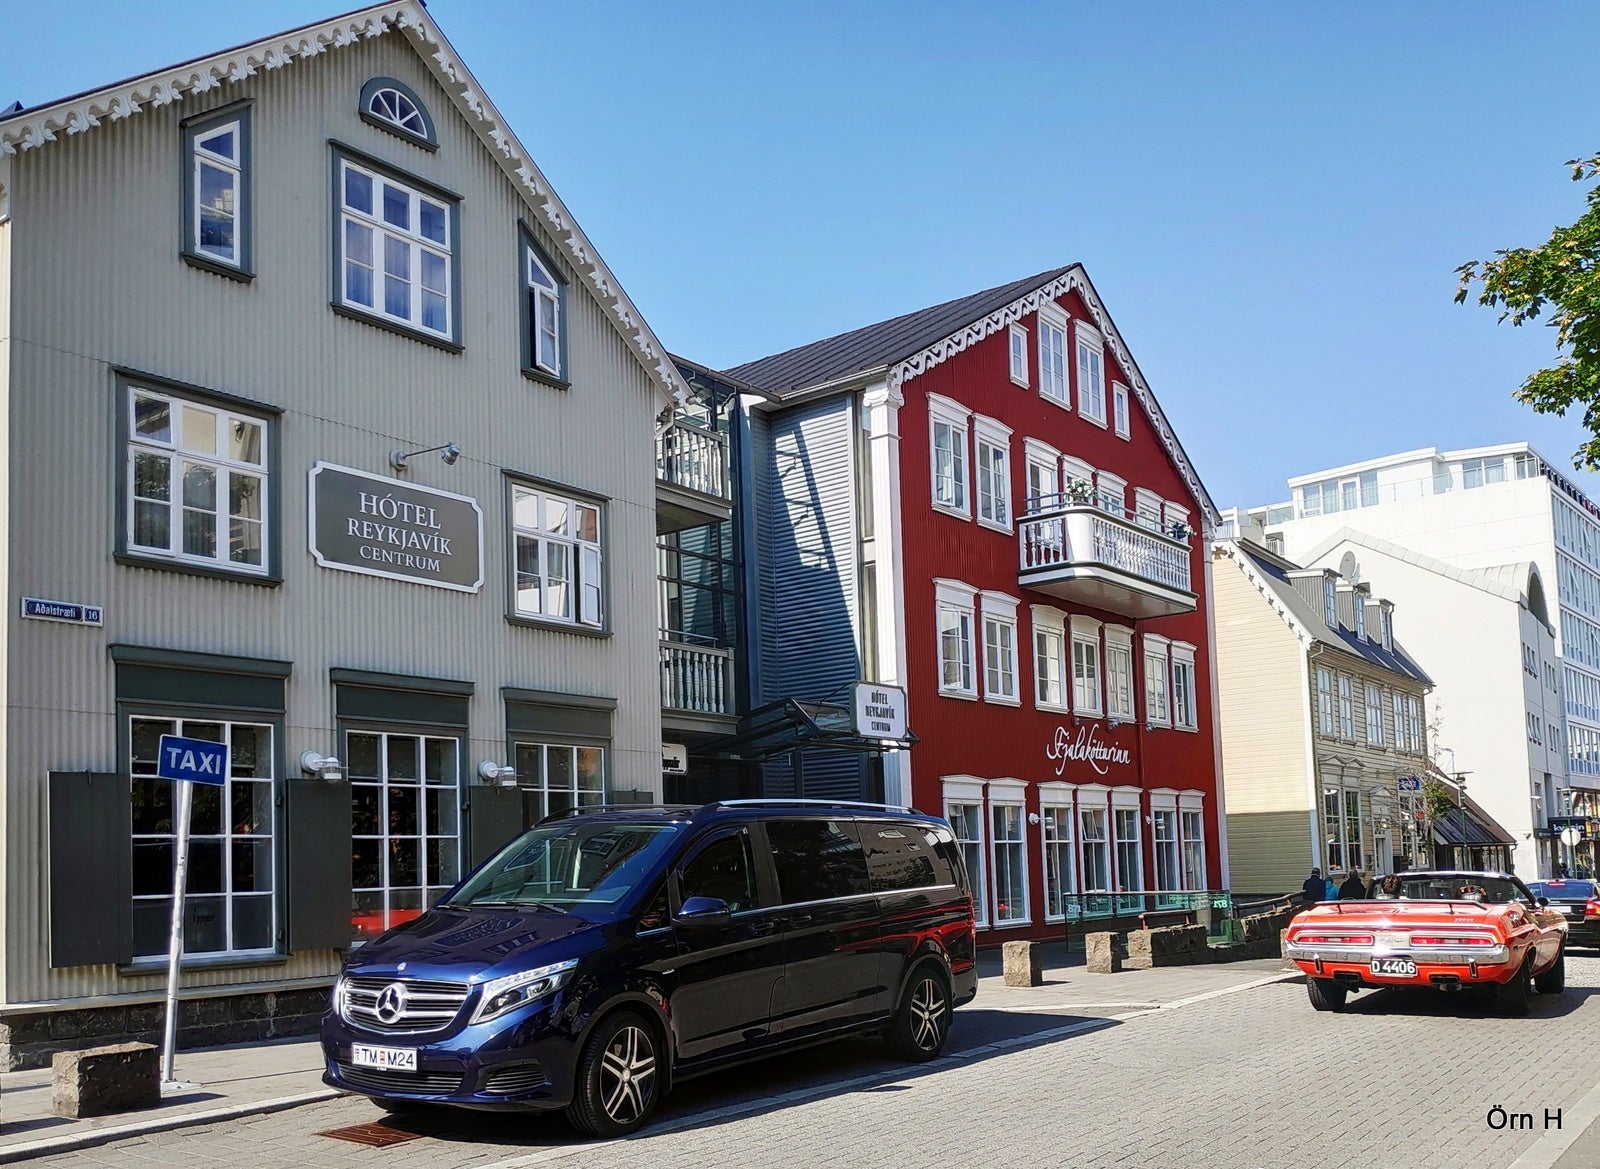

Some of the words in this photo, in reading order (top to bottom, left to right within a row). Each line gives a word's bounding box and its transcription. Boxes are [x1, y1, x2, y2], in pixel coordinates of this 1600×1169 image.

[358, 491, 442, 529] HÓTEL
[347, 517, 452, 556] REYKJAVÍK
[359, 545, 441, 572] CENTRUM
[35, 603, 76, 618] Aðalstræti
[88, 610, 98, 620] 16
[871, 690, 889, 705] HÓTEL
[166, 746, 222, 775] TAXI
[1371, 960, 1380, 973] D
[1382, 960, 1416, 974] 4406
[361, 1048, 378, 1064] TM
[387, 1050, 414, 1067] M24
